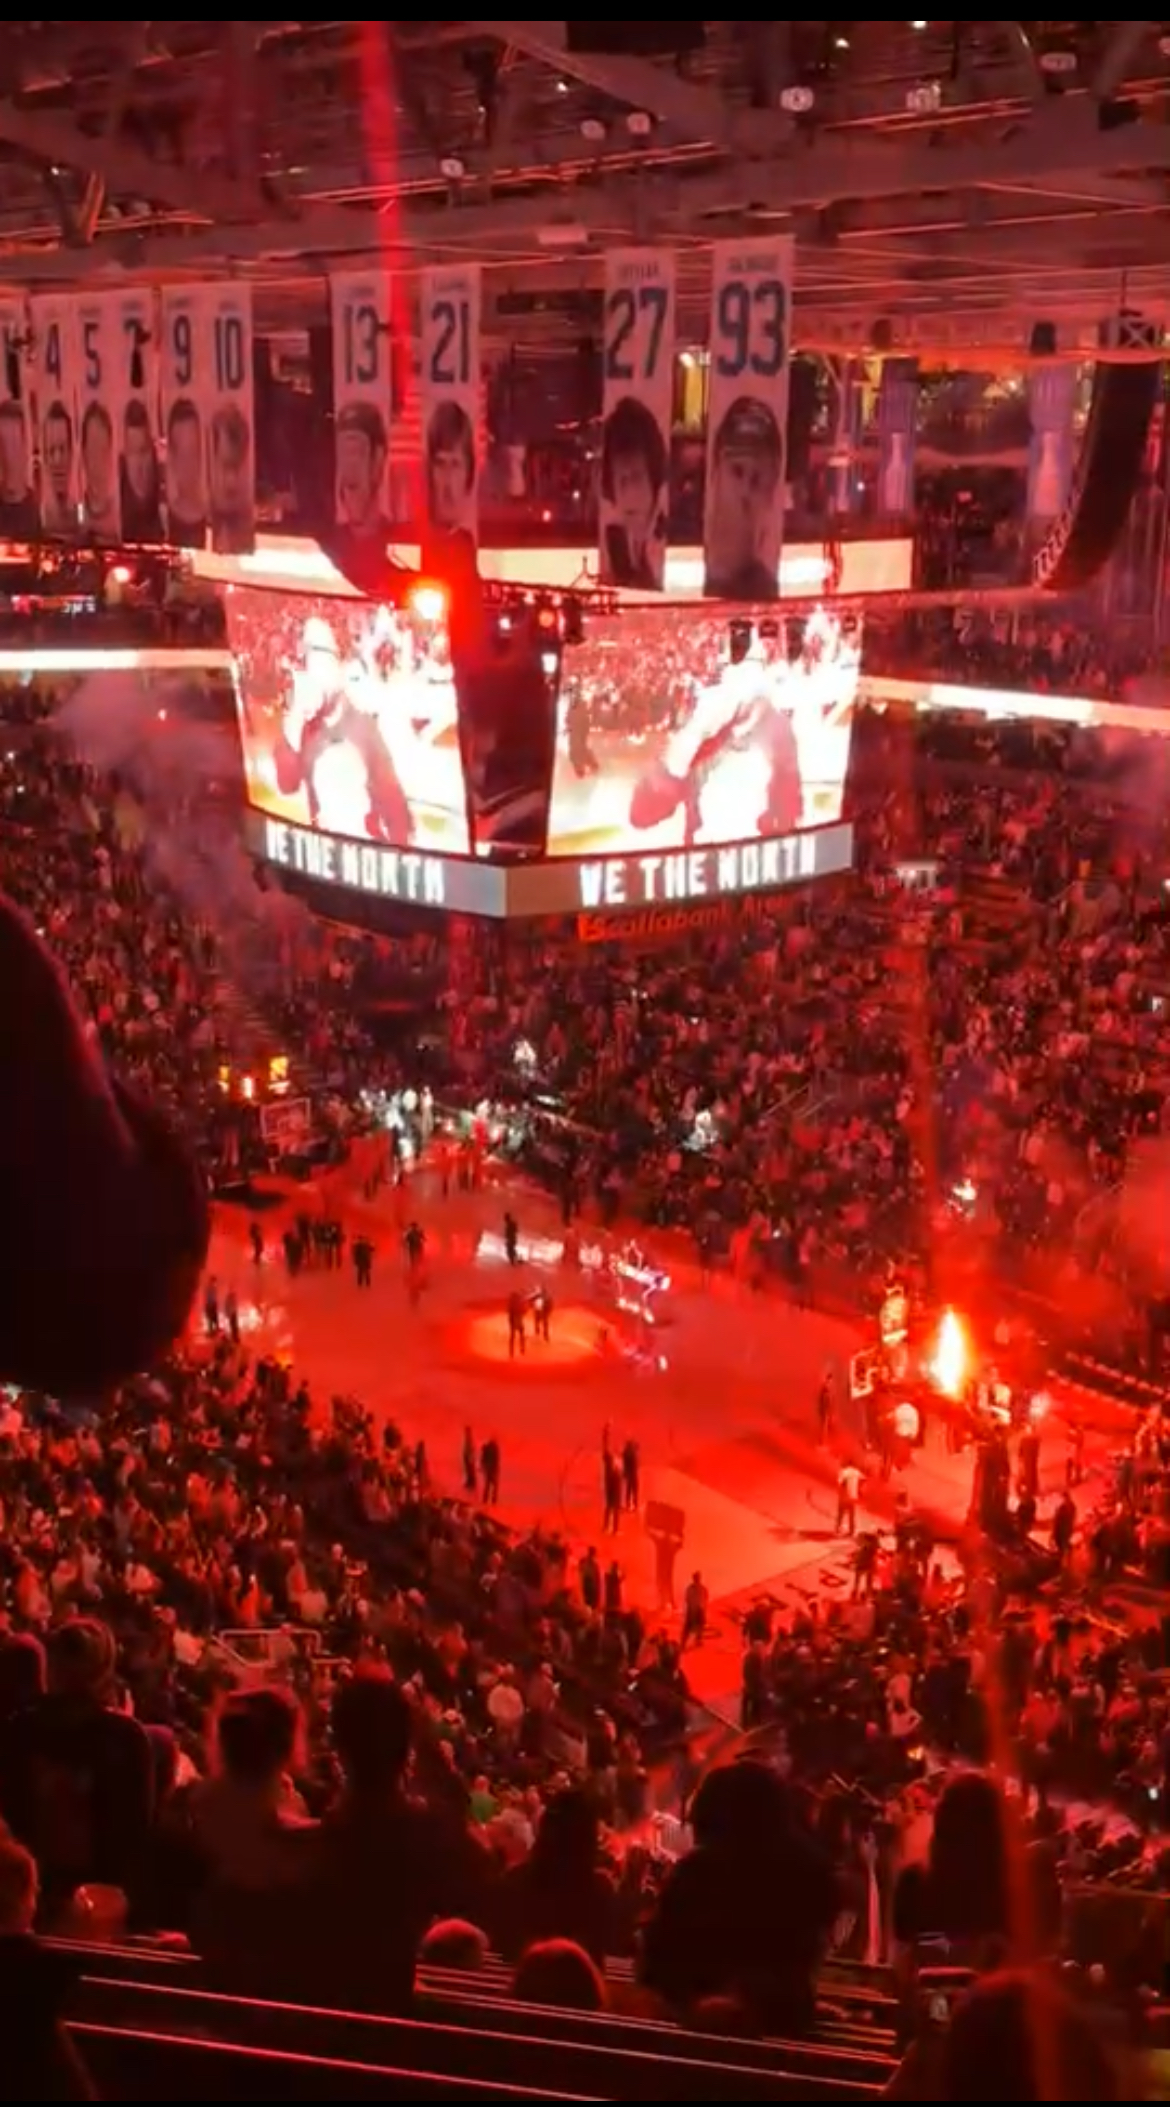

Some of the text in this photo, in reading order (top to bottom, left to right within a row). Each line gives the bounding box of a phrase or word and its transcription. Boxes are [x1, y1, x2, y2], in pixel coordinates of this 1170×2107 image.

[46, 323, 62, 391] 4
[84, 322, 100, 387] 5
[173, 315, 192, 388] 9
[214, 317, 245, 391] 10
[344, 304, 379, 384] 13
[431, 302, 469, 384] 21
[606, 287, 668, 379] 27
[717, 280, 787, 377] 93
[292, 826, 336, 880] THE
[342, 842, 446, 904] NORTH
[639, 851, 708, 900] THE
[718, 833, 816, 892] NORTH
